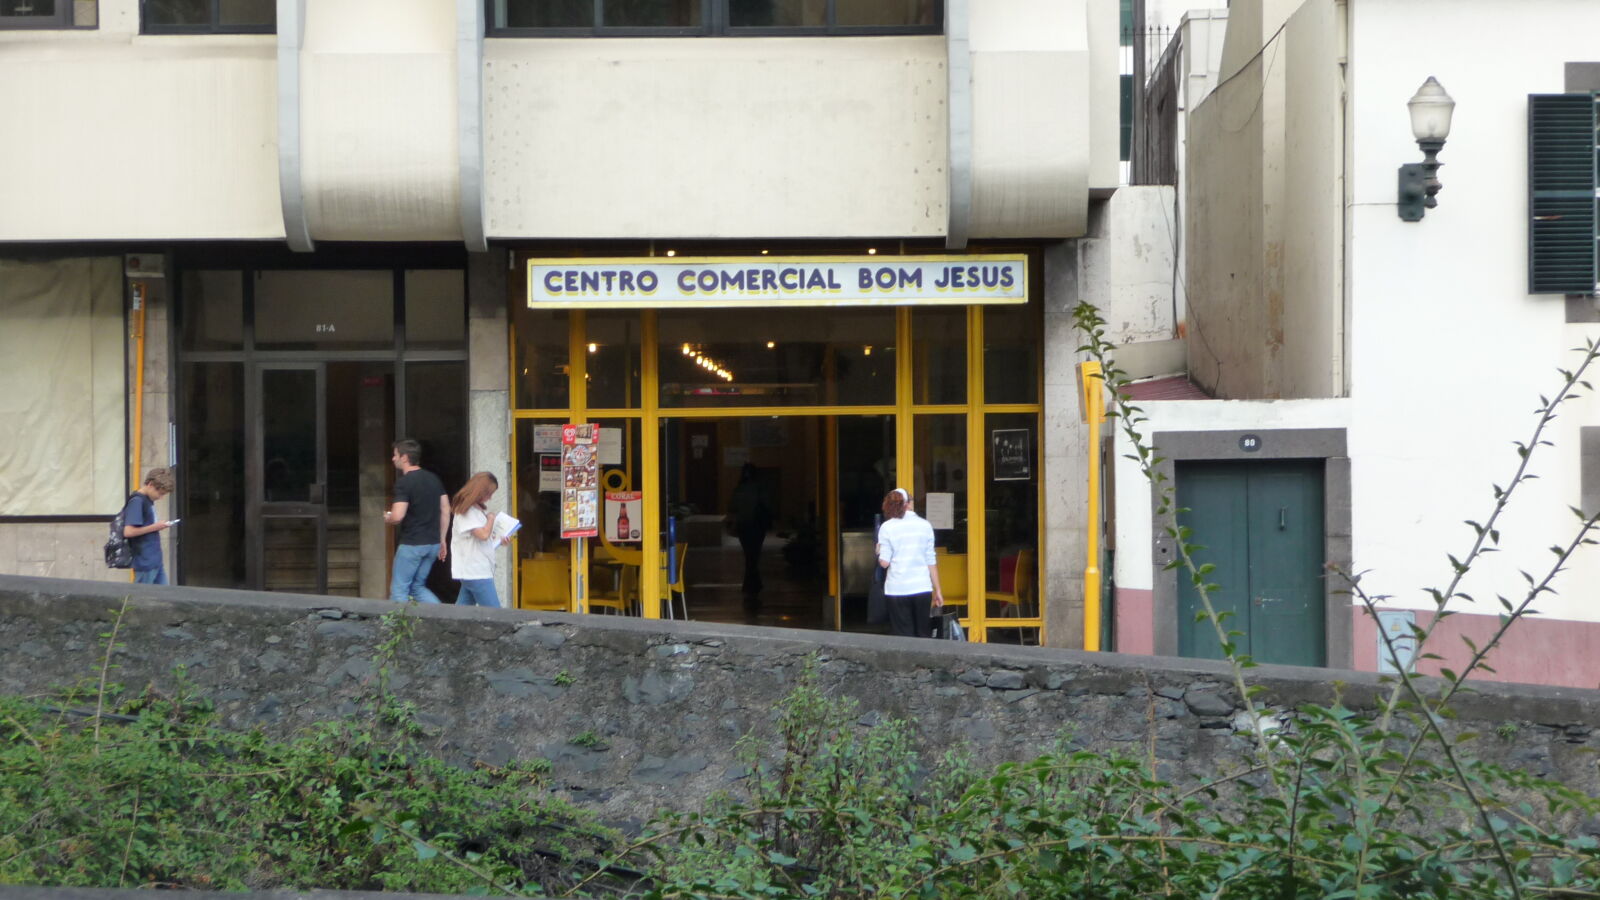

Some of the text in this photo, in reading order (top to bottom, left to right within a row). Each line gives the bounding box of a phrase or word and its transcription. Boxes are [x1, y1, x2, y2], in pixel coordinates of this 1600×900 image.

[544, 265, 1014, 292] CENTRO COMERCIAL BOM JESUS
[1245, 438, 1255, 446] 80
